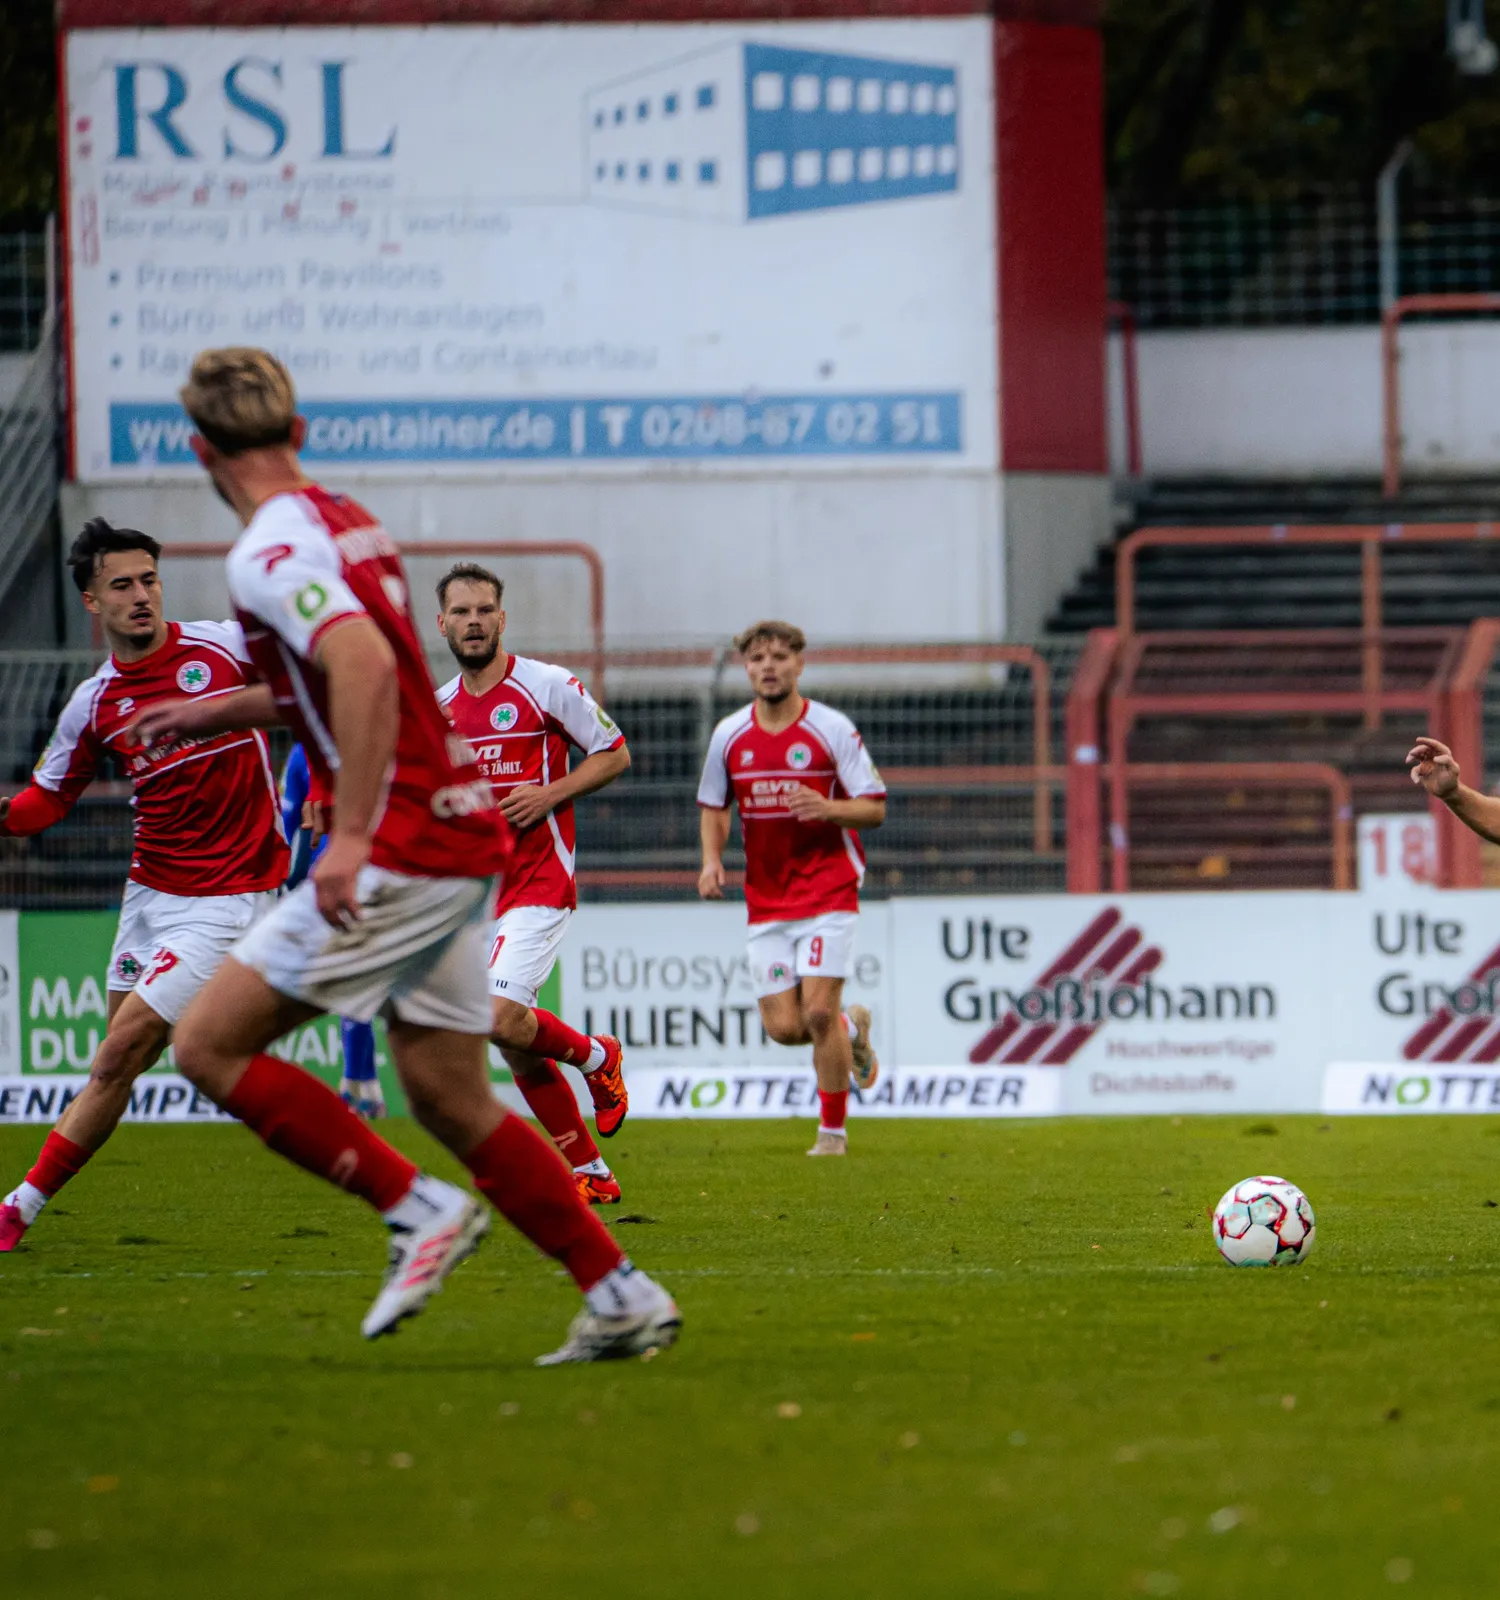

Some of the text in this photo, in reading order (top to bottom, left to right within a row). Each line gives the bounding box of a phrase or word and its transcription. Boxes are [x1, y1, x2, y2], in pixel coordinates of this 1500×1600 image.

[103, 55, 398, 163] RSL
[136, 260, 444, 292] Premium Pavillons
[241, 302, 304, 332] und
[319, 300, 544, 338] Wohnanlagen
[359, 345, 421, 371] und
[433, 341, 658, 371] Containerbau
[603, 406, 633, 447] T
[826, 403, 878, 444] 02
[892, 402, 942, 442] 51
[1370, 825, 1427, 880] 18
[807, 935, 824, 968] 9
[940, 916, 1031, 962] Ute
[1374, 911, 1464, 957] Ute
[943, 969, 1277, 1025] Großjohann
